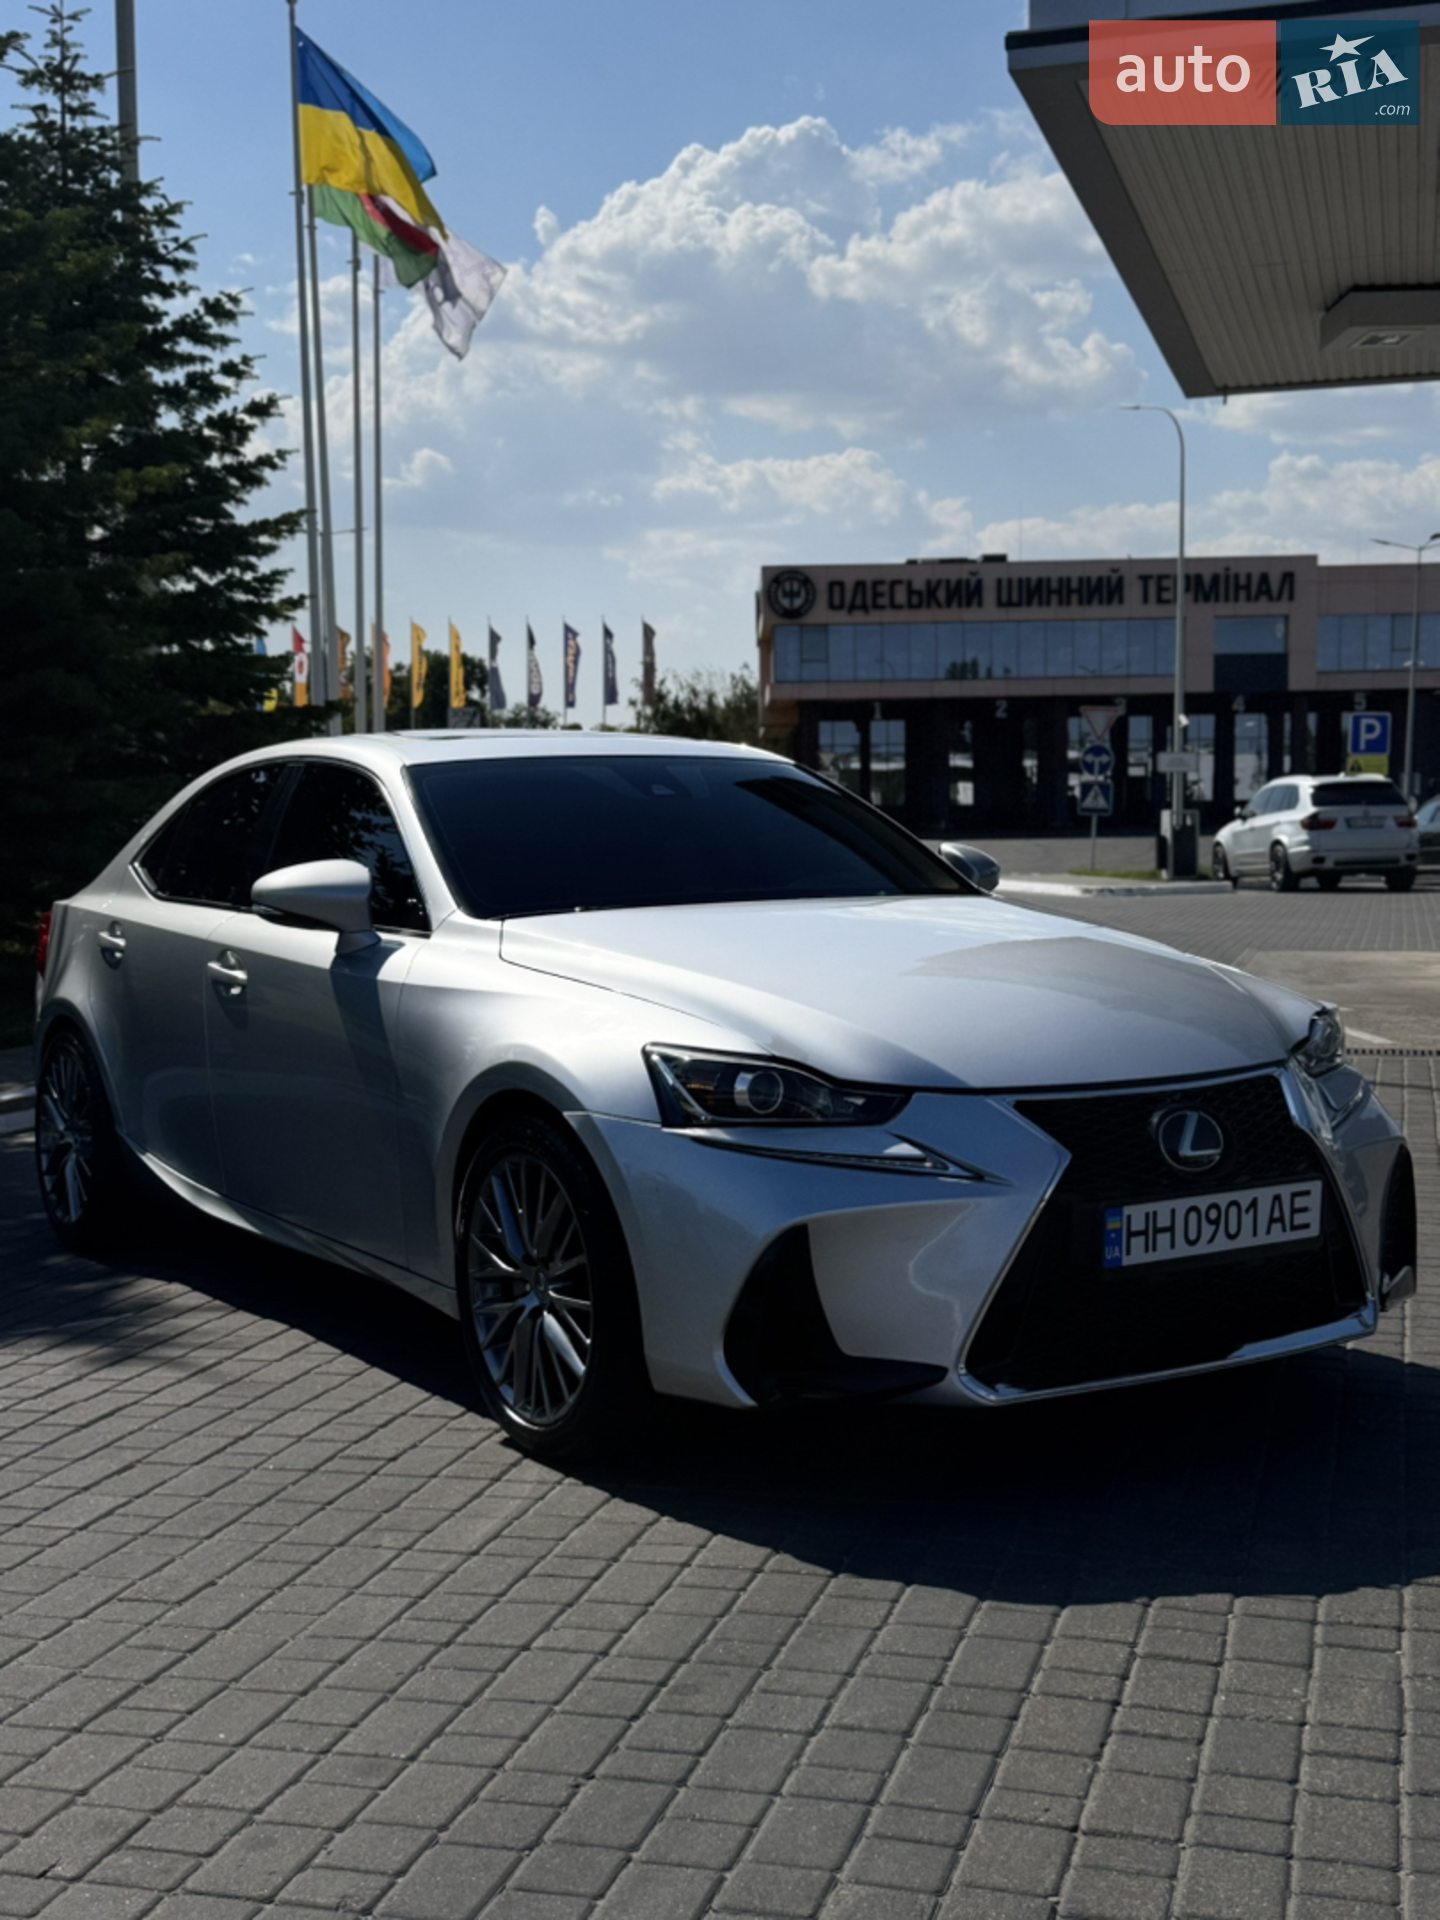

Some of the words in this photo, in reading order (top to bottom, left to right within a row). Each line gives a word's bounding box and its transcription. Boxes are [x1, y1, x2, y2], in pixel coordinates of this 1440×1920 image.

[828, 571, 983, 615] ОДЕСЬКИЙ
[996, 568, 1124, 608] ШИННИЙ
[1359, 717, 1382, 751] P
[1105, 1246, 1121, 1260] UA
